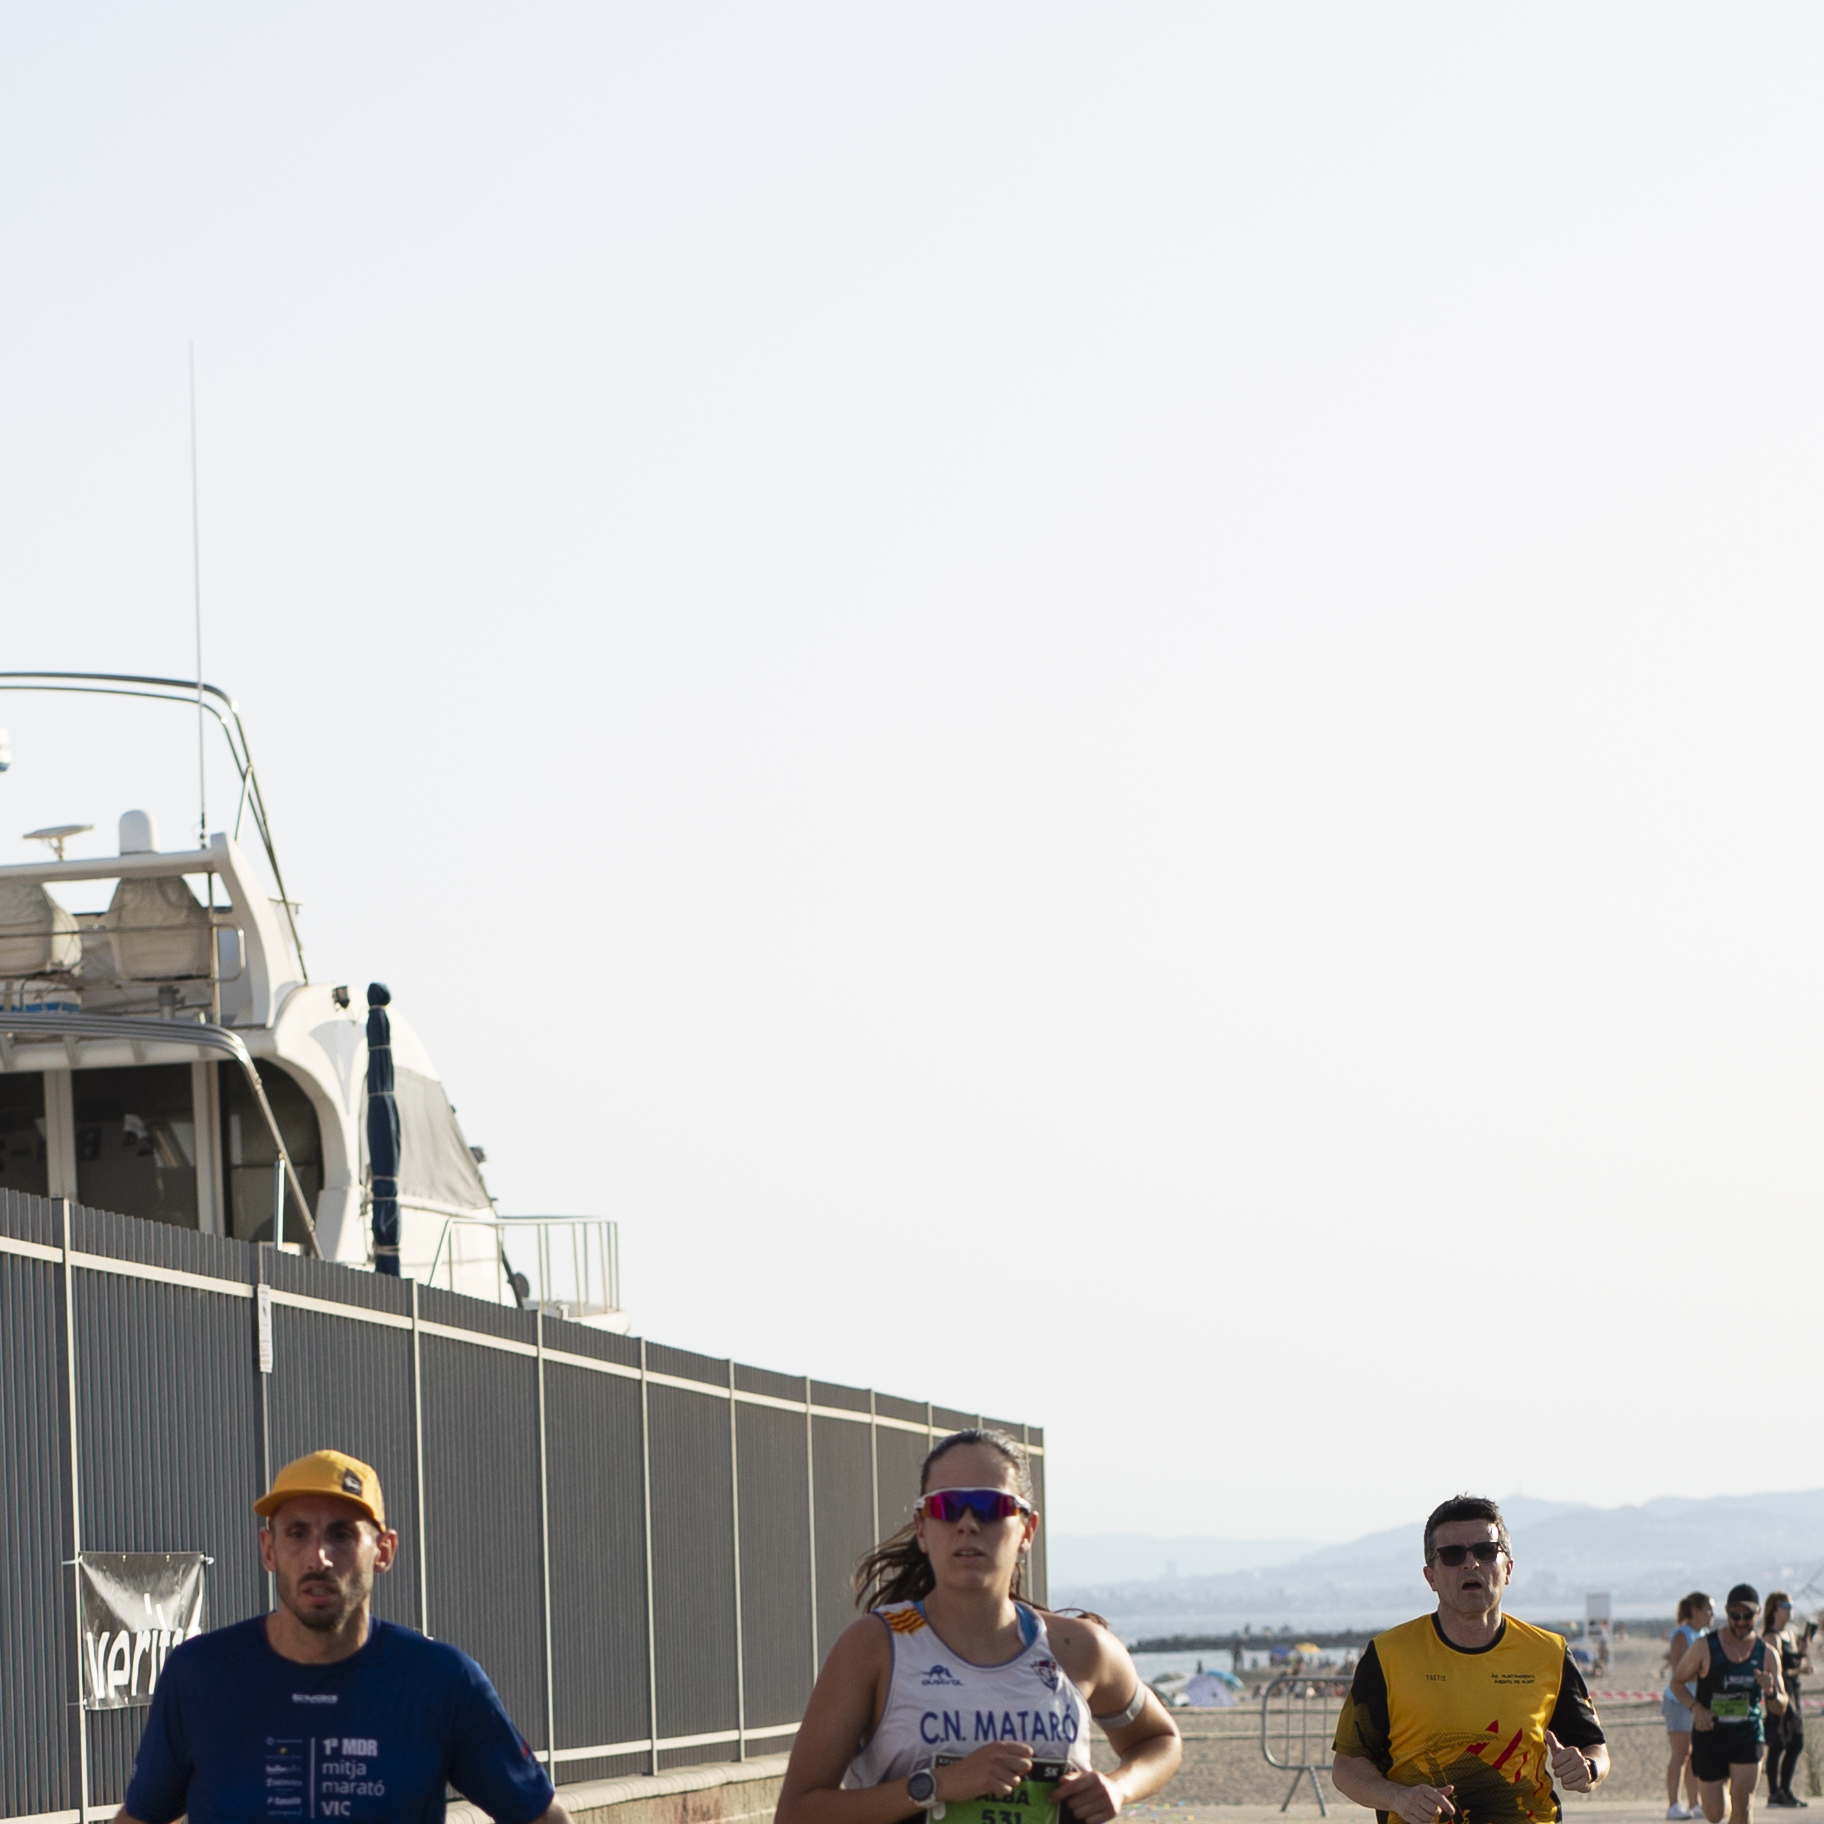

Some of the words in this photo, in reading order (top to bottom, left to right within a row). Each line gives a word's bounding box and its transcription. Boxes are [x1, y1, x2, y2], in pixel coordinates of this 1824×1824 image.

[86, 1592, 202, 1699] verit
[919, 1710, 967, 1744] C.N.
[974, 1704, 1079, 1744] MATARÓ
[342, 1738, 379, 1757] MDR
[322, 1760, 367, 1779] mitja
[321, 1779, 385, 1797] marató
[321, 1801, 352, 1817] VIC
